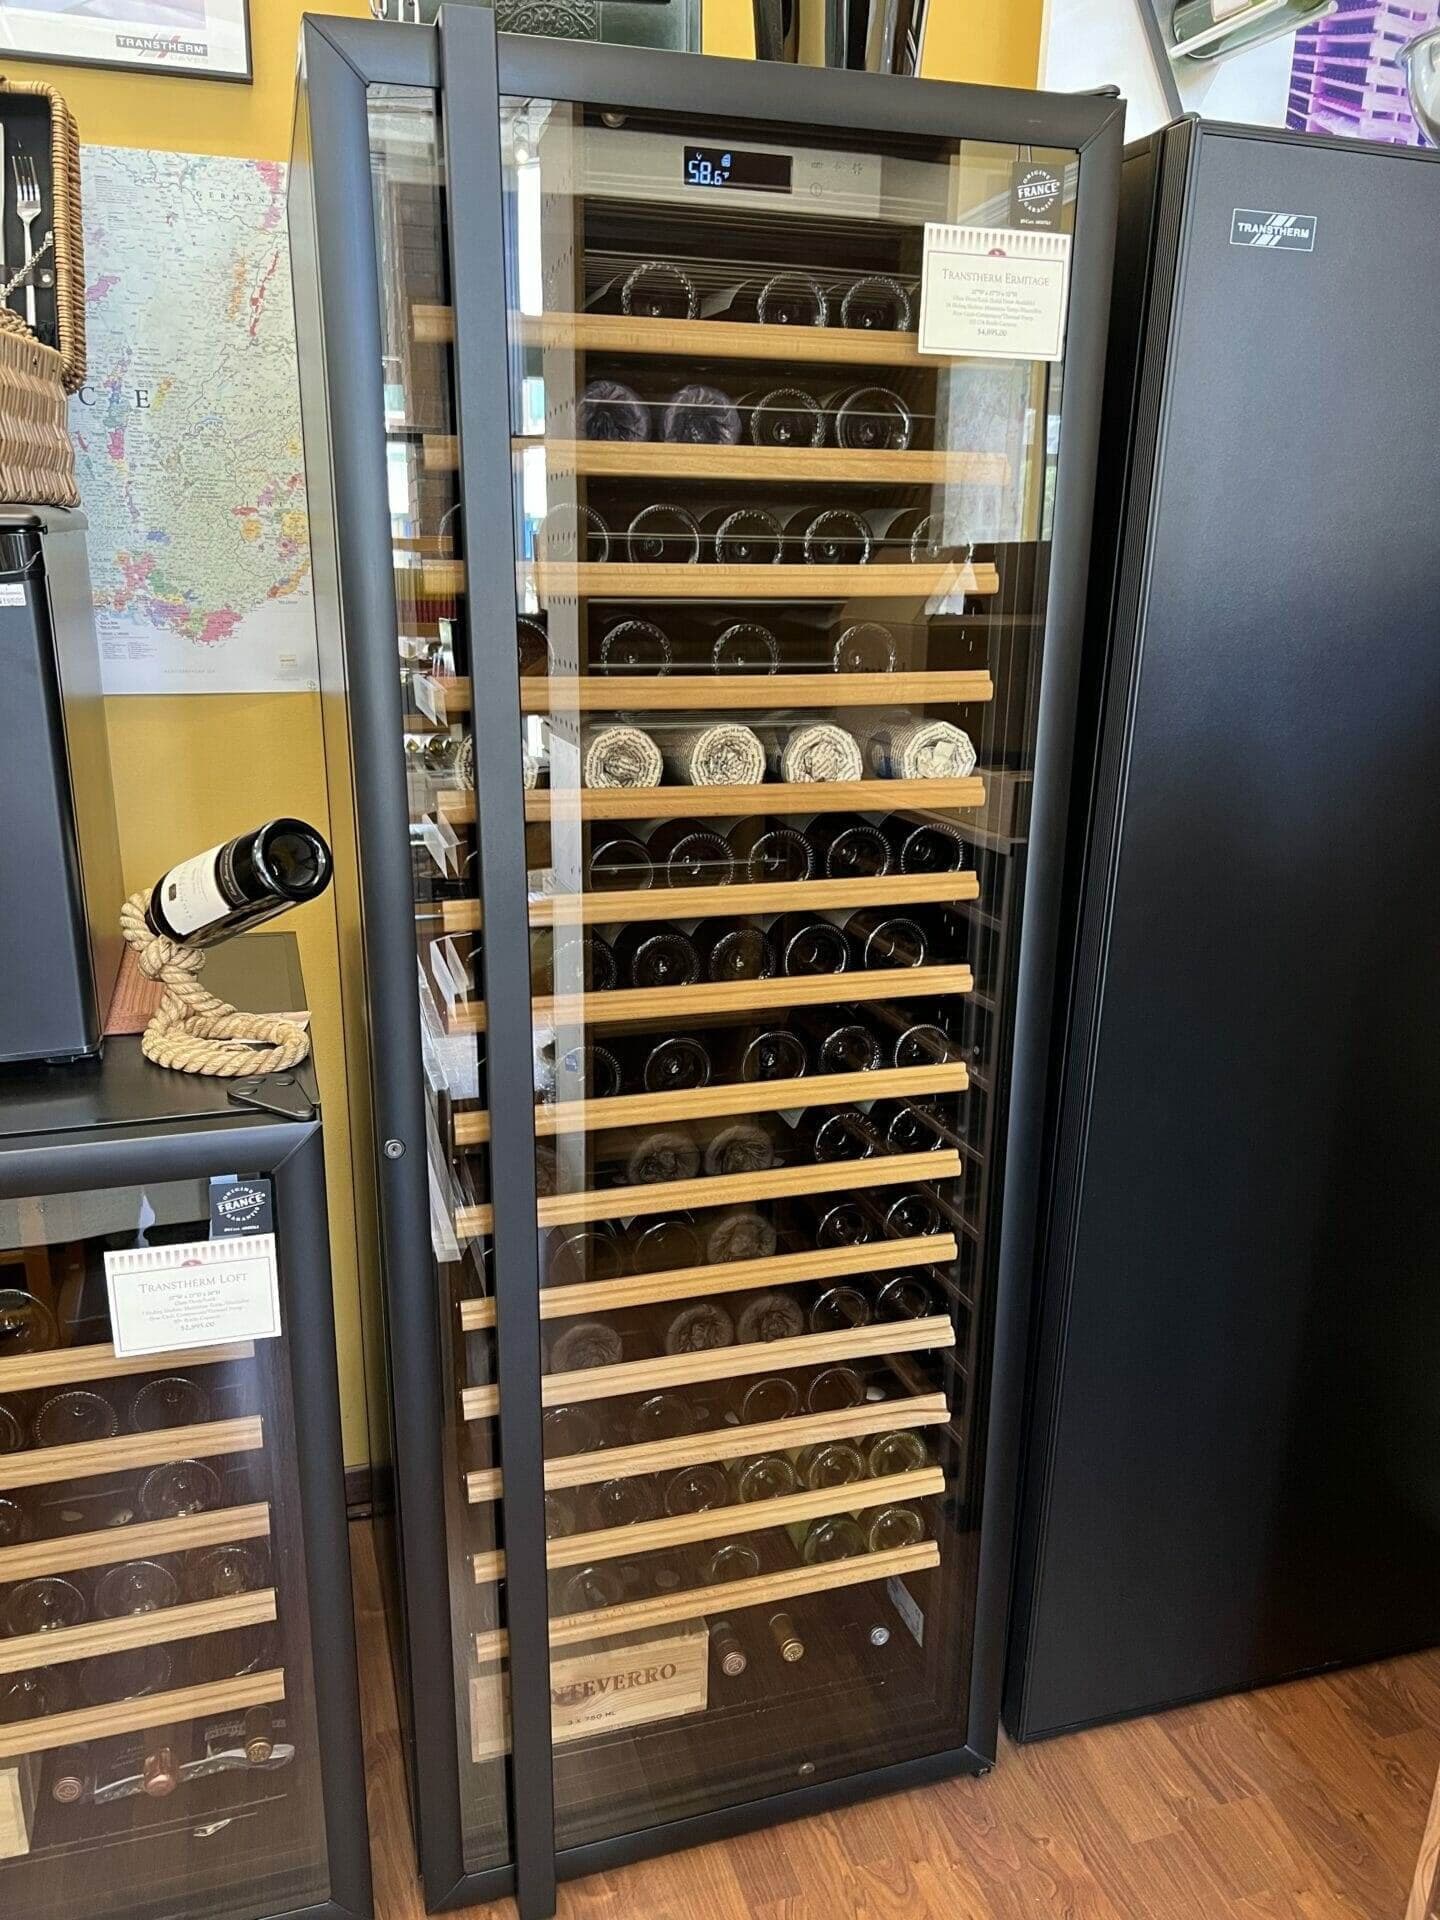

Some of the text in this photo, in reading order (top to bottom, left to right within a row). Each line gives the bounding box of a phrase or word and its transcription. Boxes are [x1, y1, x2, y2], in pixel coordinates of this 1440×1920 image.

[118, 37, 204, 54] TRANSTHERM
[1018, 182, 1057, 198] FRANCE
[1237, 222, 1310, 239] TRANSTHERM
[218, 1195, 264, 1213] FRANCE
[220, 1273, 248, 1284] LOFT
[552, 1663, 677, 1703] NTEVERRO
